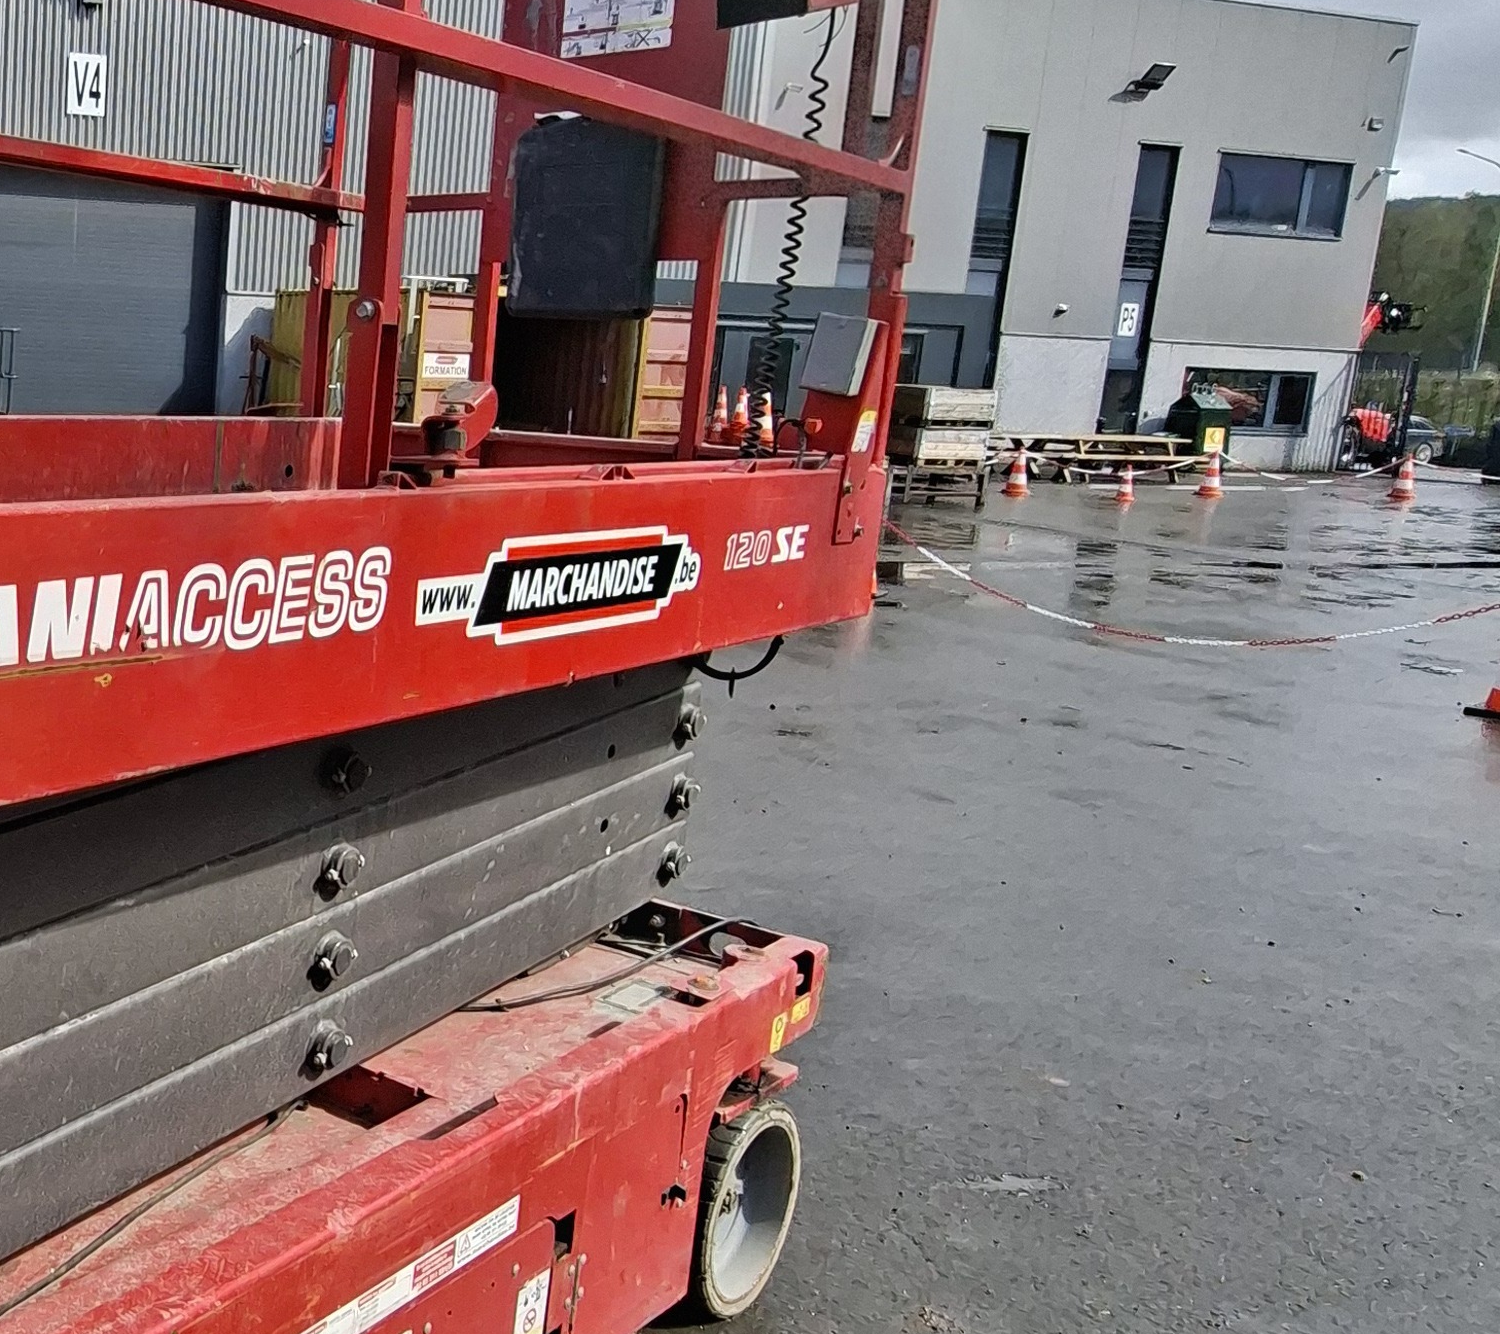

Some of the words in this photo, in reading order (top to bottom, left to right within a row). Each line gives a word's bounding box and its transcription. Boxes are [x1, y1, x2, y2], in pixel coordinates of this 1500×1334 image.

[73, 61, 102, 109] V4
[1119, 307, 1136, 332] P5
[424, 366, 467, 375] FORMATION
